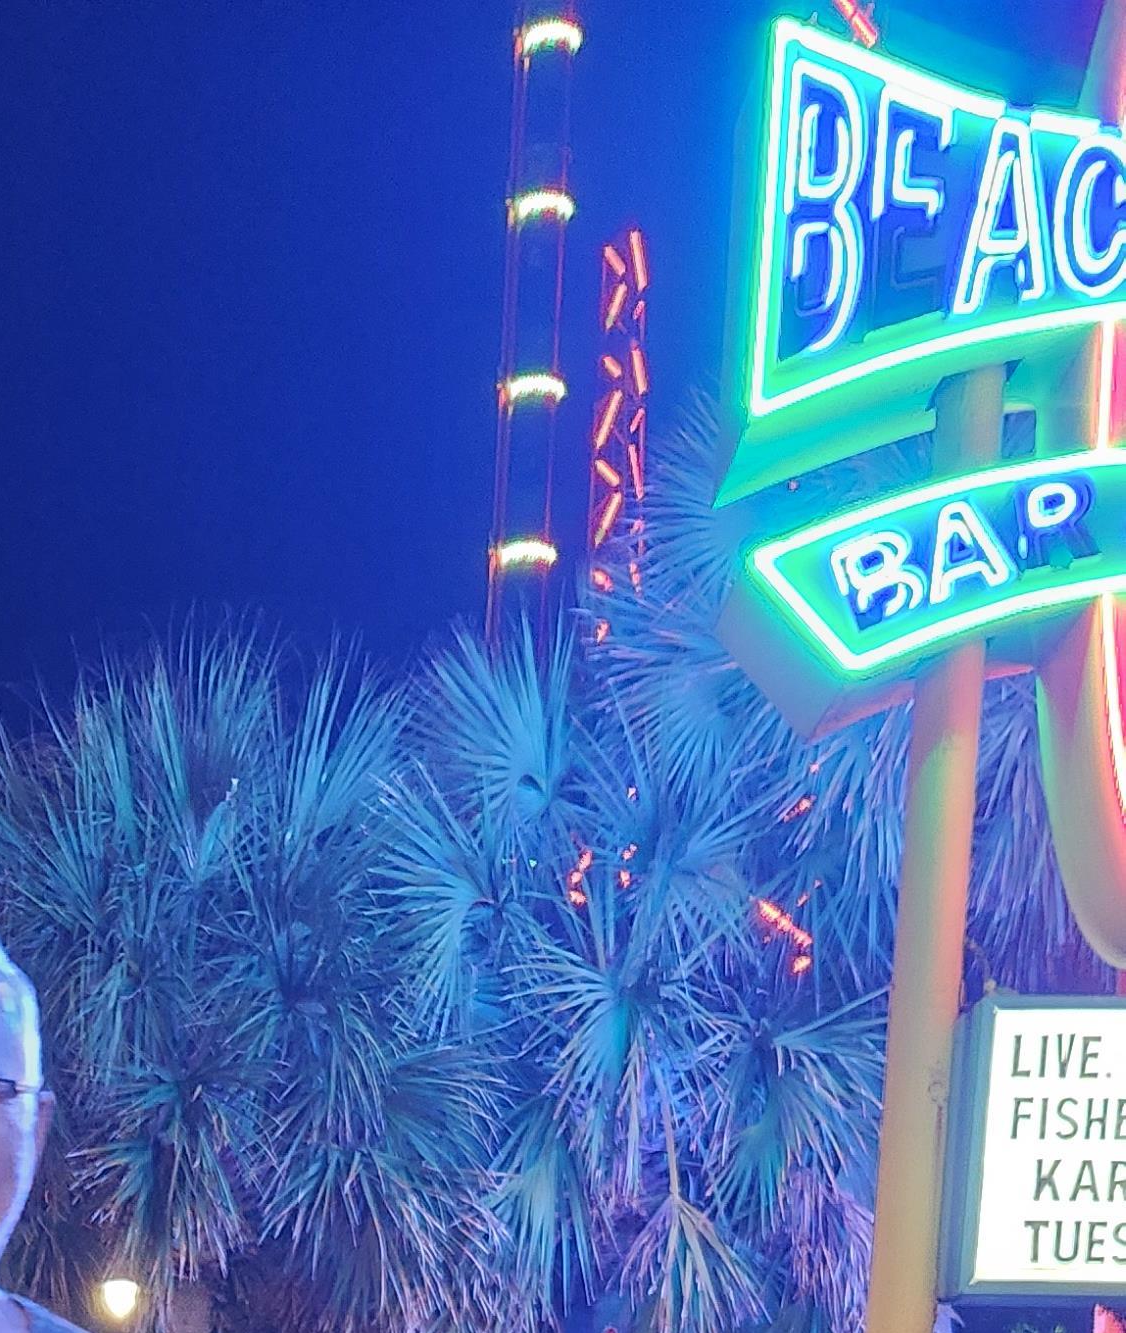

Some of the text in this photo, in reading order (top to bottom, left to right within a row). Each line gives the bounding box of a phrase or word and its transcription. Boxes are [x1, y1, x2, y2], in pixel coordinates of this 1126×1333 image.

[829, 475, 1102, 622] BAR
[1010, 1033, 1112, 1079] LIVE.
[1032, 1159, 1126, 1203] KAR
